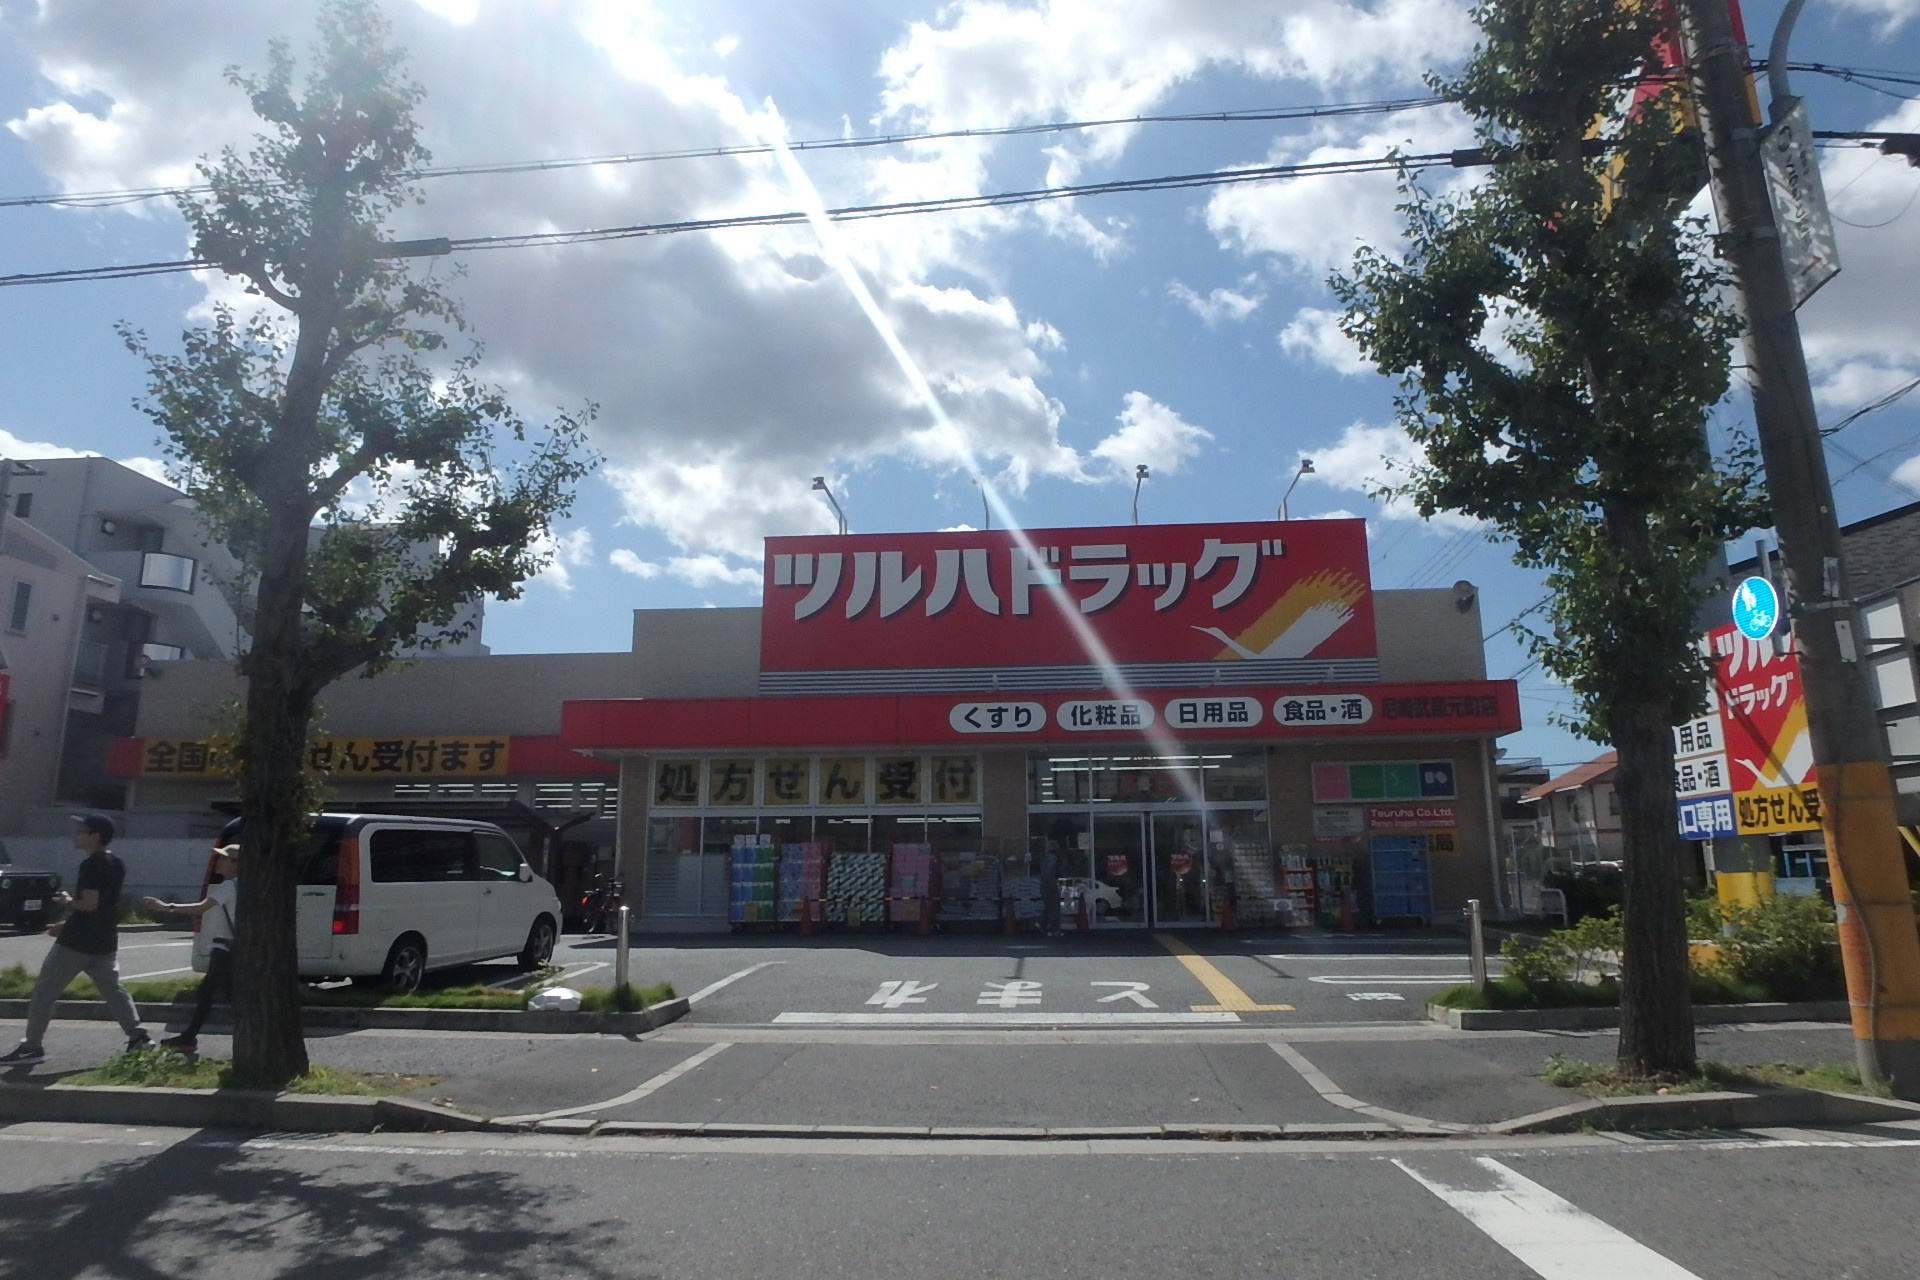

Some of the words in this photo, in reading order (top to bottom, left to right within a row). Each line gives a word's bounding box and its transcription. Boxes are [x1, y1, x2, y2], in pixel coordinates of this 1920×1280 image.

[773, 538, 1283, 621] ツルハドラッグ
[1283, 698, 1363, 722] 食品・酒
[1725, 671, 1794, 720] ドラッグ
[964, 706, 1031, 729] くすり
[1071, 704, 1141, 727] 化粧品
[1178, 701, 1249, 724] 日用品
[658, 760, 975, 801] 処方せん受付
[1678, 799, 1733, 835] 口専用
